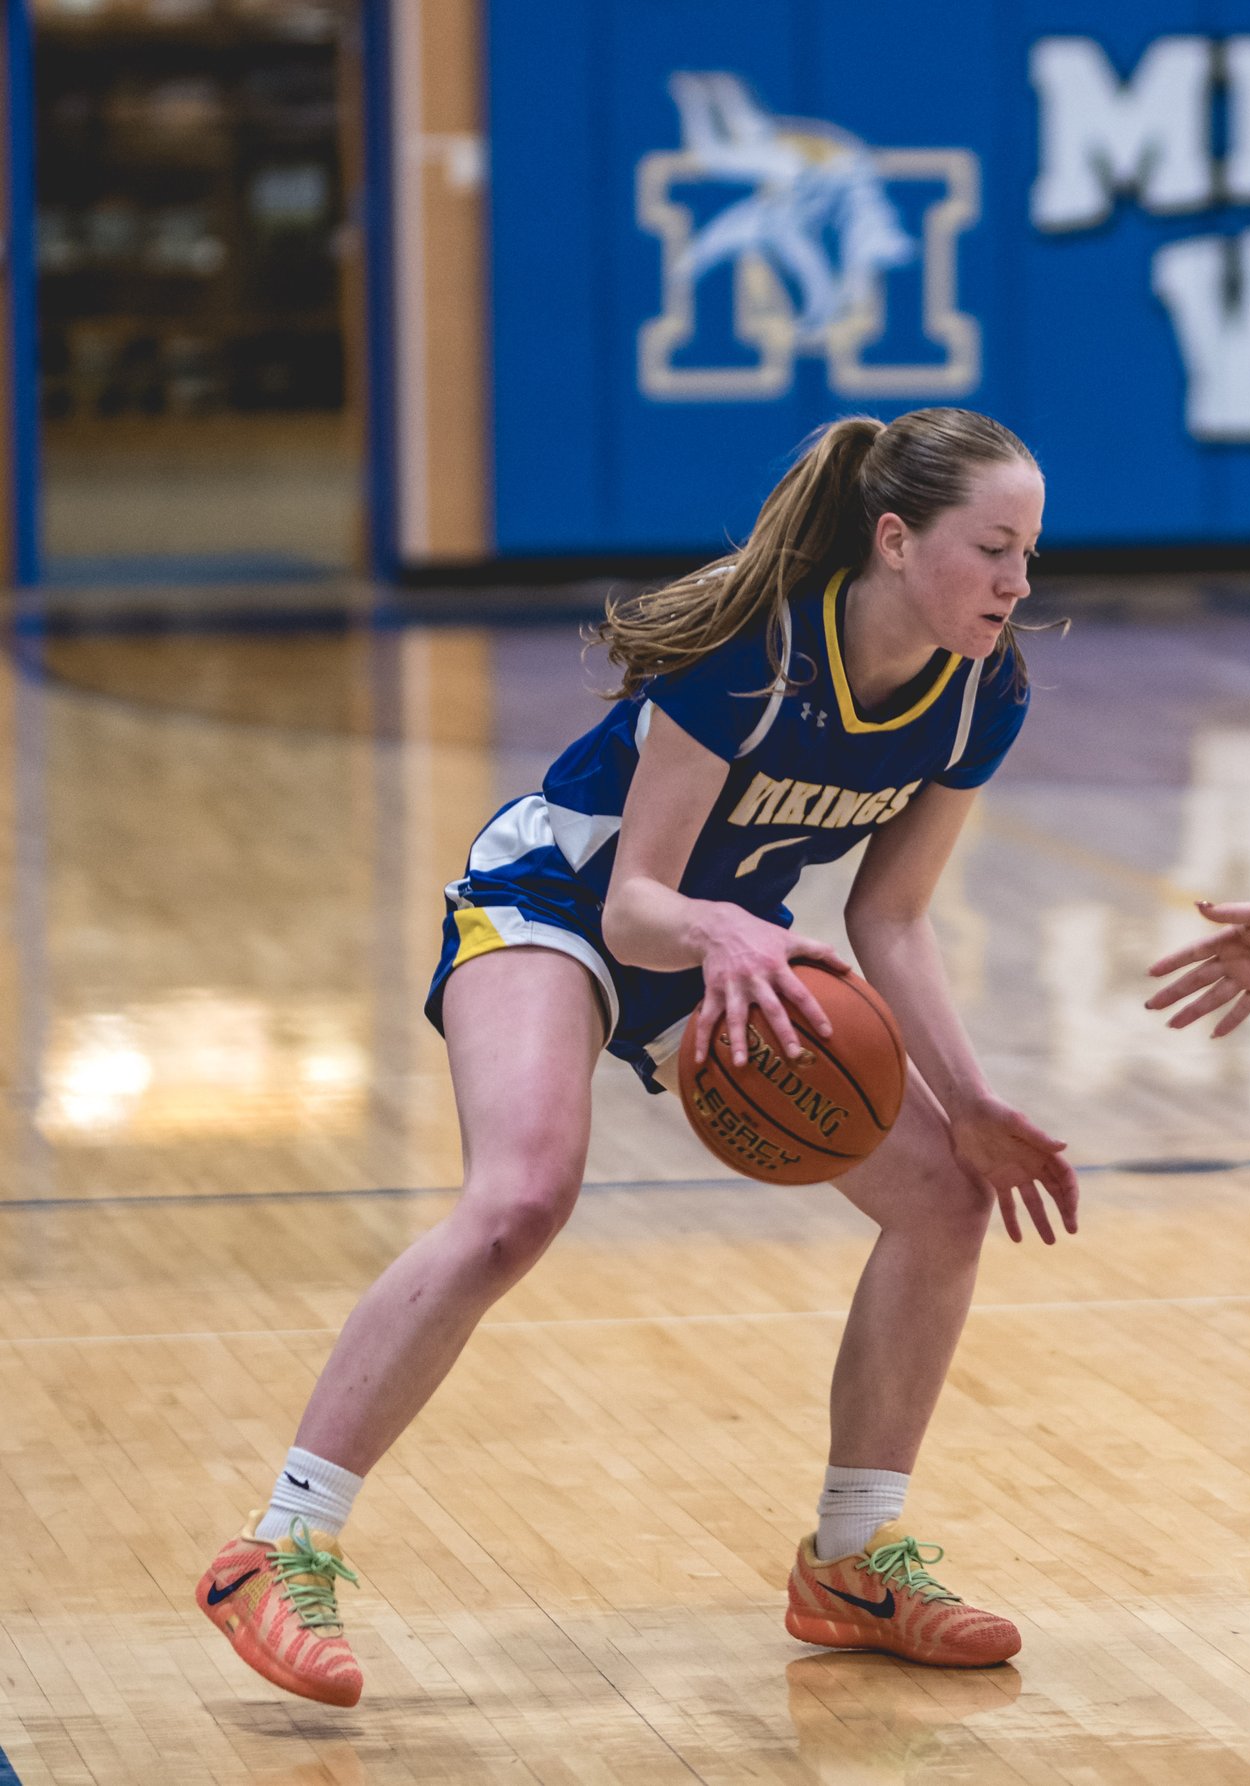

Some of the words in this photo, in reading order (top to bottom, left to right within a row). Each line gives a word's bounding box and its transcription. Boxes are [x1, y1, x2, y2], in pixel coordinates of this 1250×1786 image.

[727, 771, 922, 828] VIKINGS
[694, 1067, 801, 1165] LEGACY
[720, 1023, 849, 1137] PALDING
